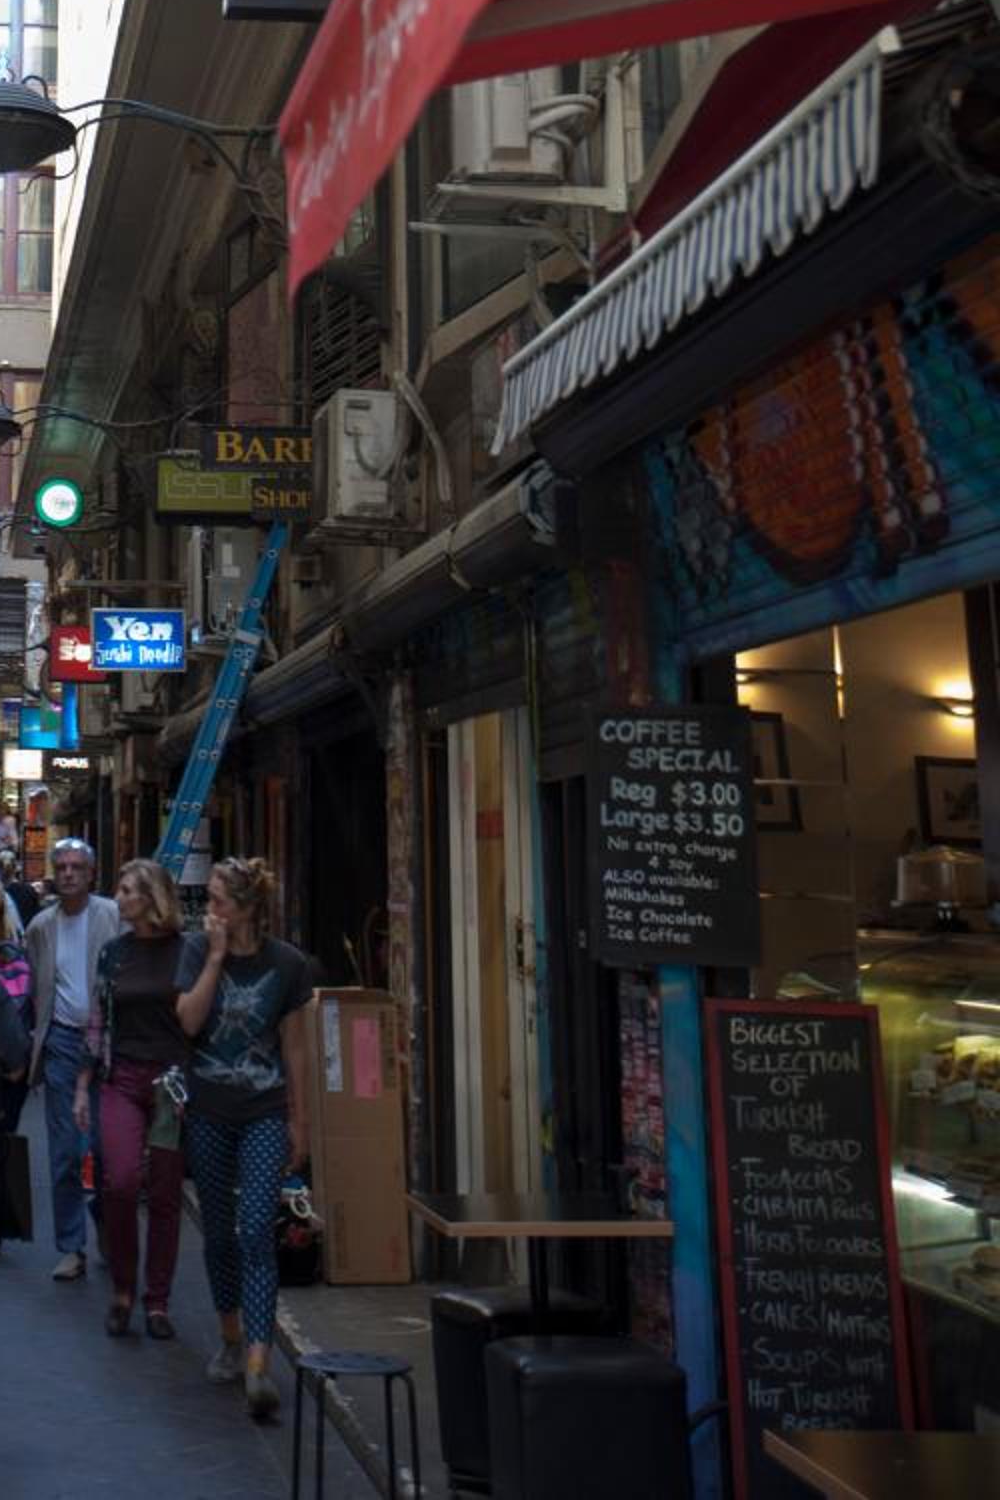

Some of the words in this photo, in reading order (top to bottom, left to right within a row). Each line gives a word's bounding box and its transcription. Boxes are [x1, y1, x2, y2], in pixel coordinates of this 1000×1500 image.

[103, 615, 174, 642] Yen
[600, 719, 701, 745] COFFEE
[627, 746, 742, 772] SPECIAL
[610, 776, 656, 808] Reg
[670, 779, 740, 806] $3.00
[600, 802, 670, 836] Large
[672, 811, 744, 837] $3.50
[684, 841, 738, 862] charge
[602, 869, 645, 884] ALSO
[604, 886, 686, 907] Milkshakes
[605, 903, 633, 921] Ice
[639, 907, 713, 929] Chocolate
[607, 924, 635, 941] Ice
[638, 926, 692, 944] Coffee
[731, 1039, 860, 1075] SELECTION
[769, 1075, 808, 1098] OF
